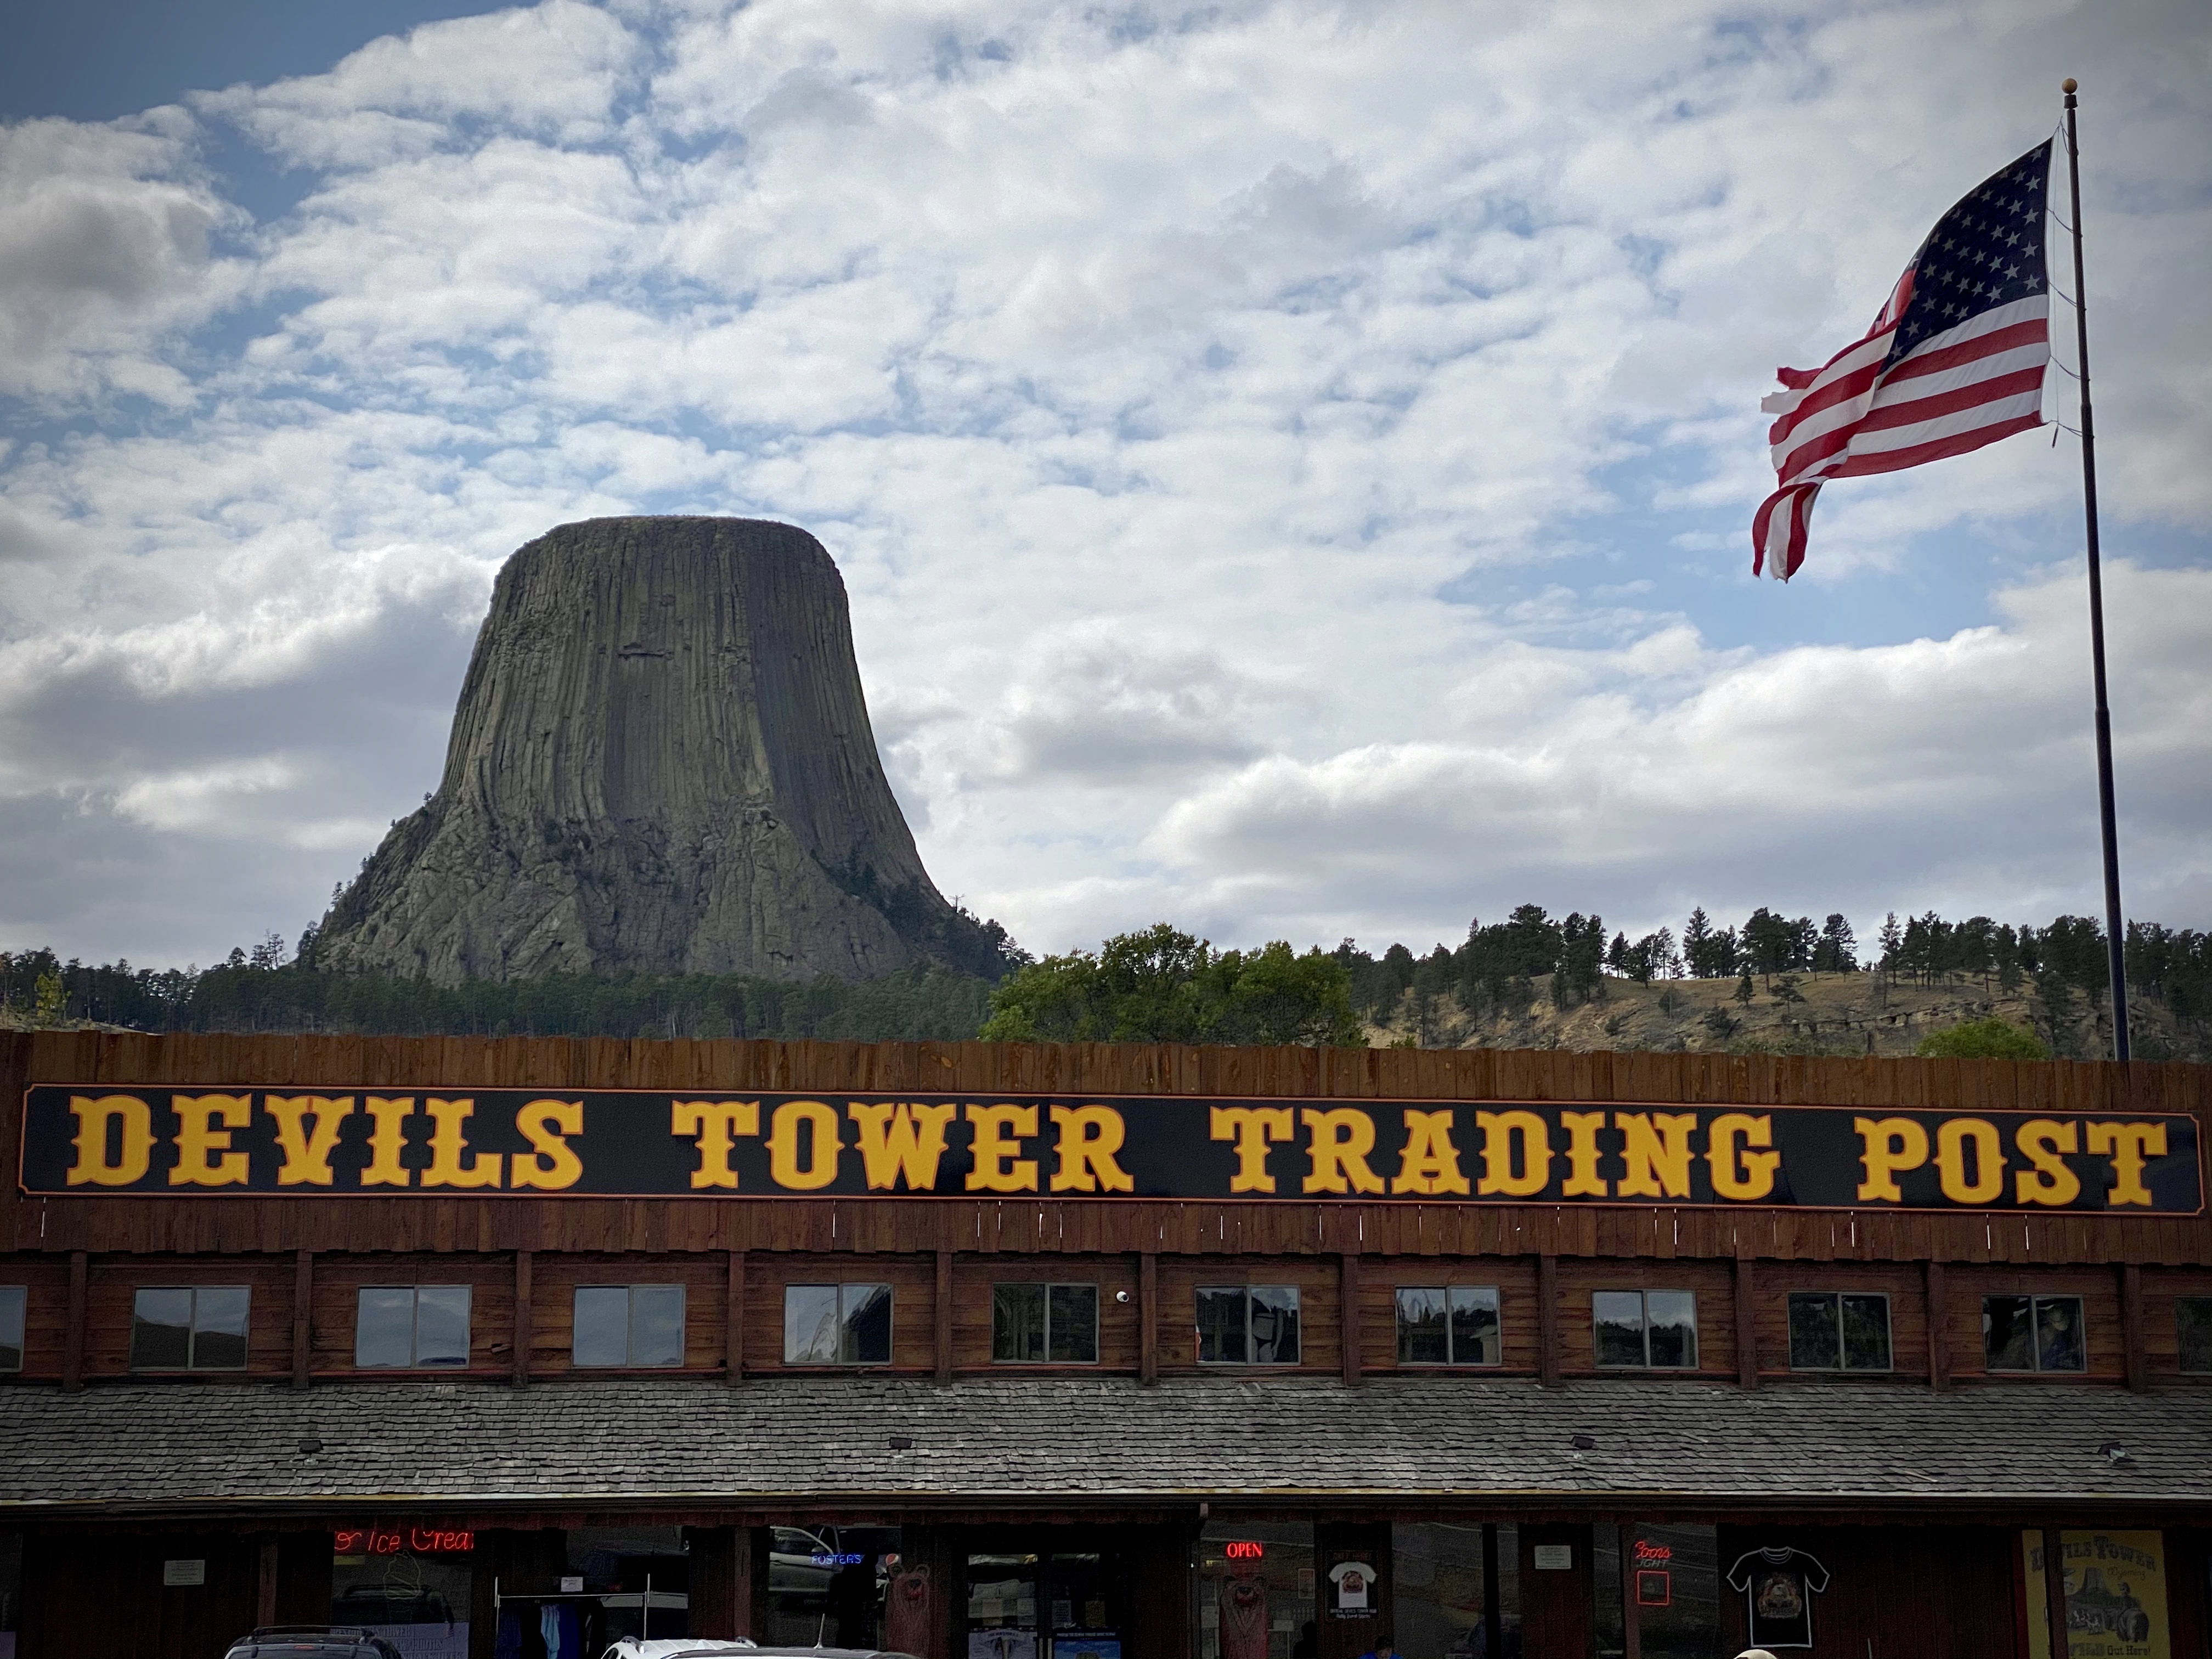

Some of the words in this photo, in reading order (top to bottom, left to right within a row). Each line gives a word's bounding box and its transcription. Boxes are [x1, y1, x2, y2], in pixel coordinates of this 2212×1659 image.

[66, 1093, 584, 1190] DEVILS
[671, 1099, 1135, 1193] TOWER
[1210, 1106, 1781, 1200] TRADING
[1854, 1116, 2168, 1207] POST
[368, 1531, 400, 1553] Ice
[1226, 1542, 1263, 1558] OPEN
[811, 1553, 862, 1565] FOSTER'S
[2107, 1566, 2146, 1580] Wyoming
